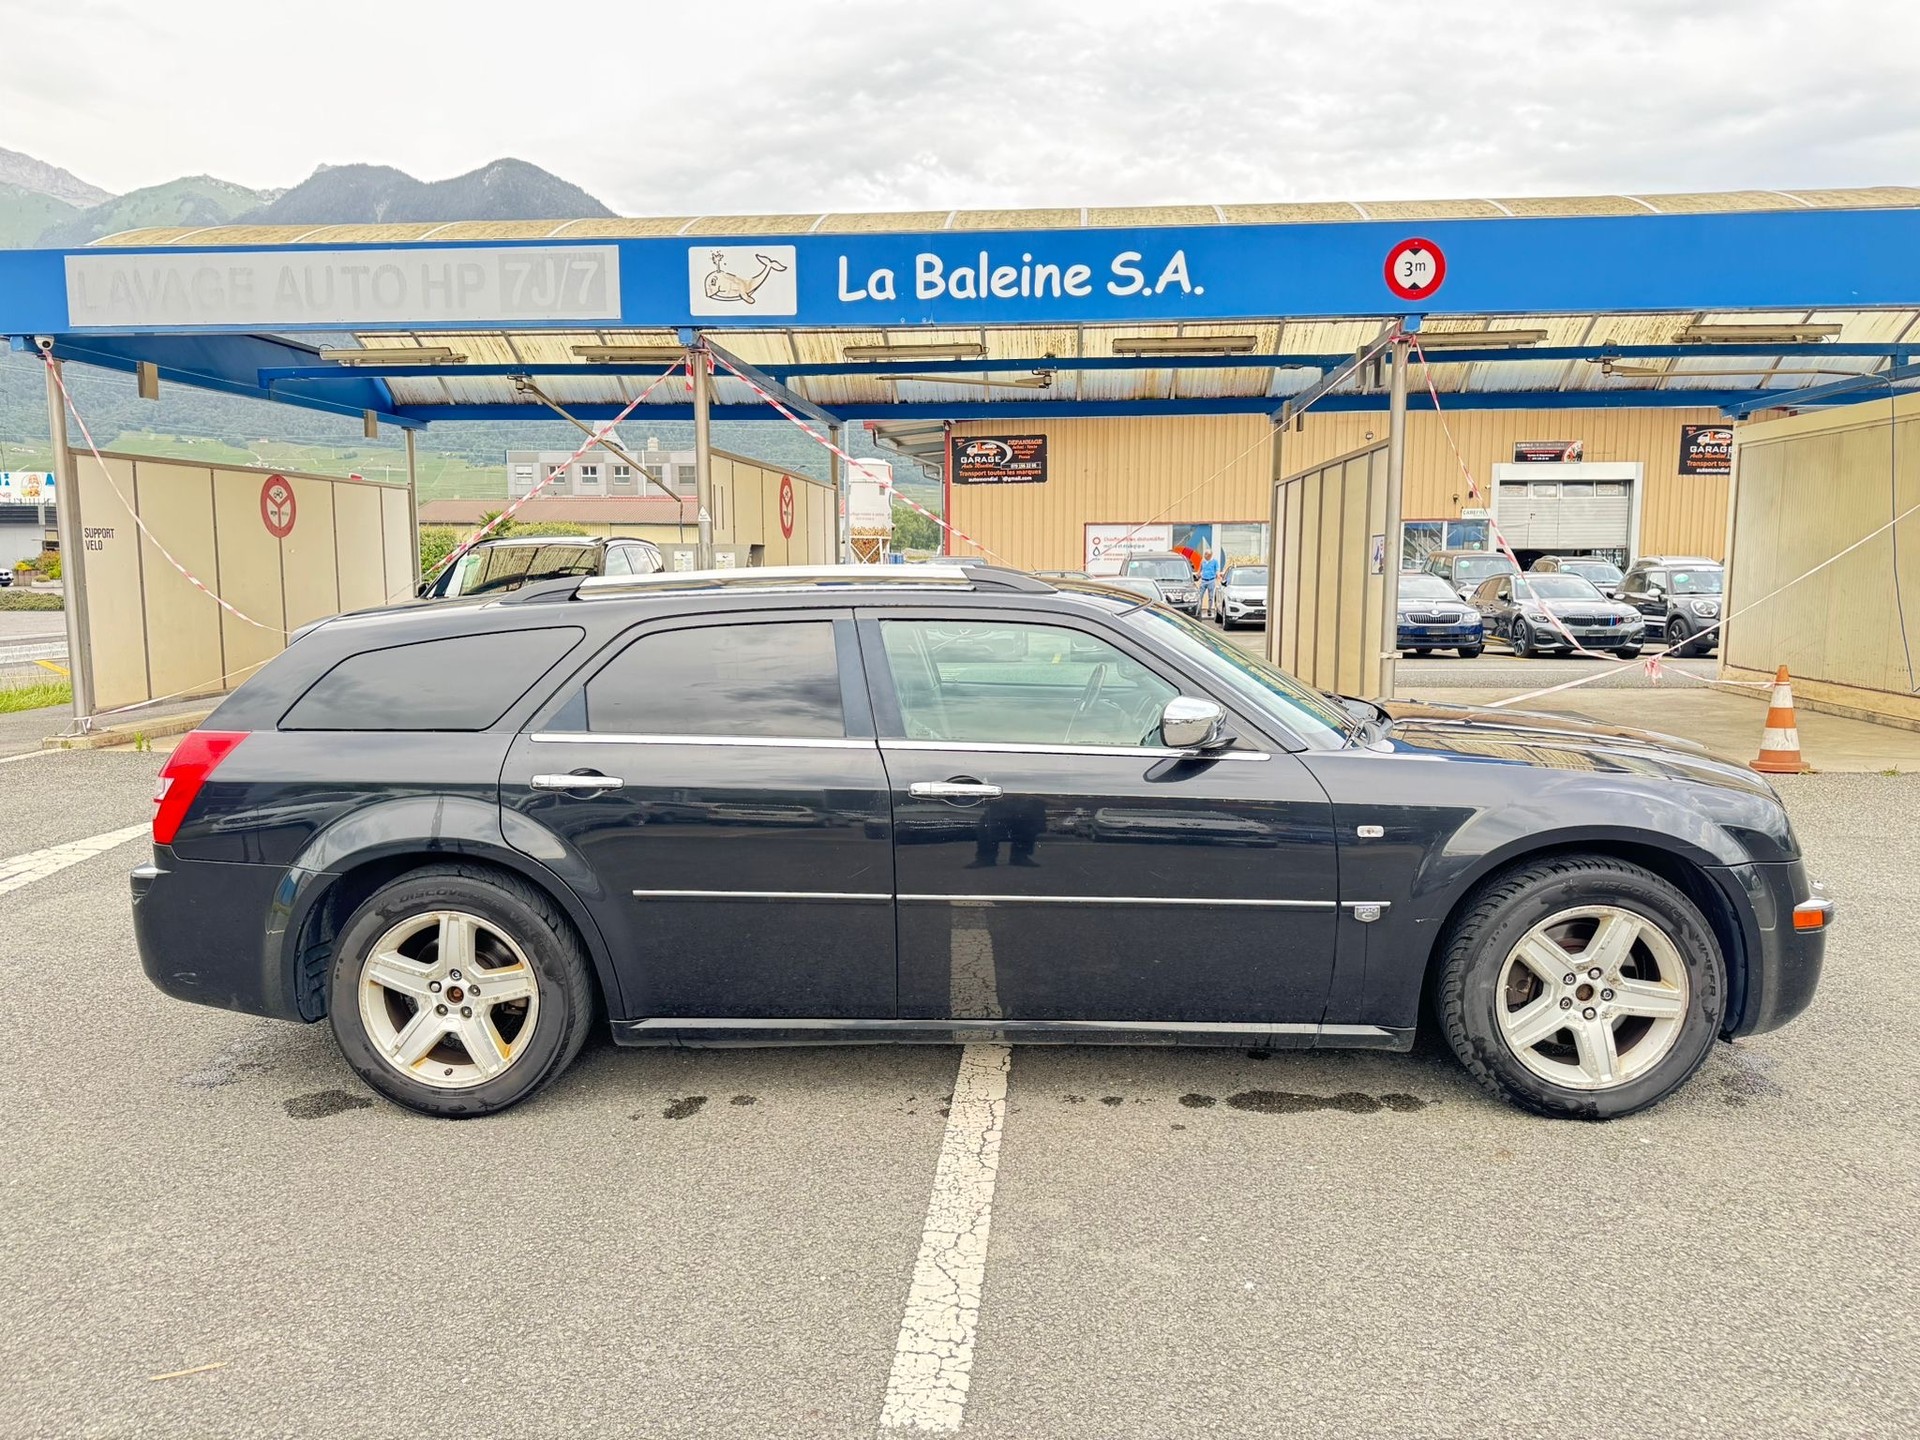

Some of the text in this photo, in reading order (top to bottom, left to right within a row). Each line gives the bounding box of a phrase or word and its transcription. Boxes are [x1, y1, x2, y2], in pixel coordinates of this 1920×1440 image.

[77, 256, 600, 313] LAVAGE AUTO HP 7J/7
[838, 249, 1205, 302] La Baleine S.A.
[84, 527, 115, 539] SUPPORT
[84, 539, 103, 551] VELO
